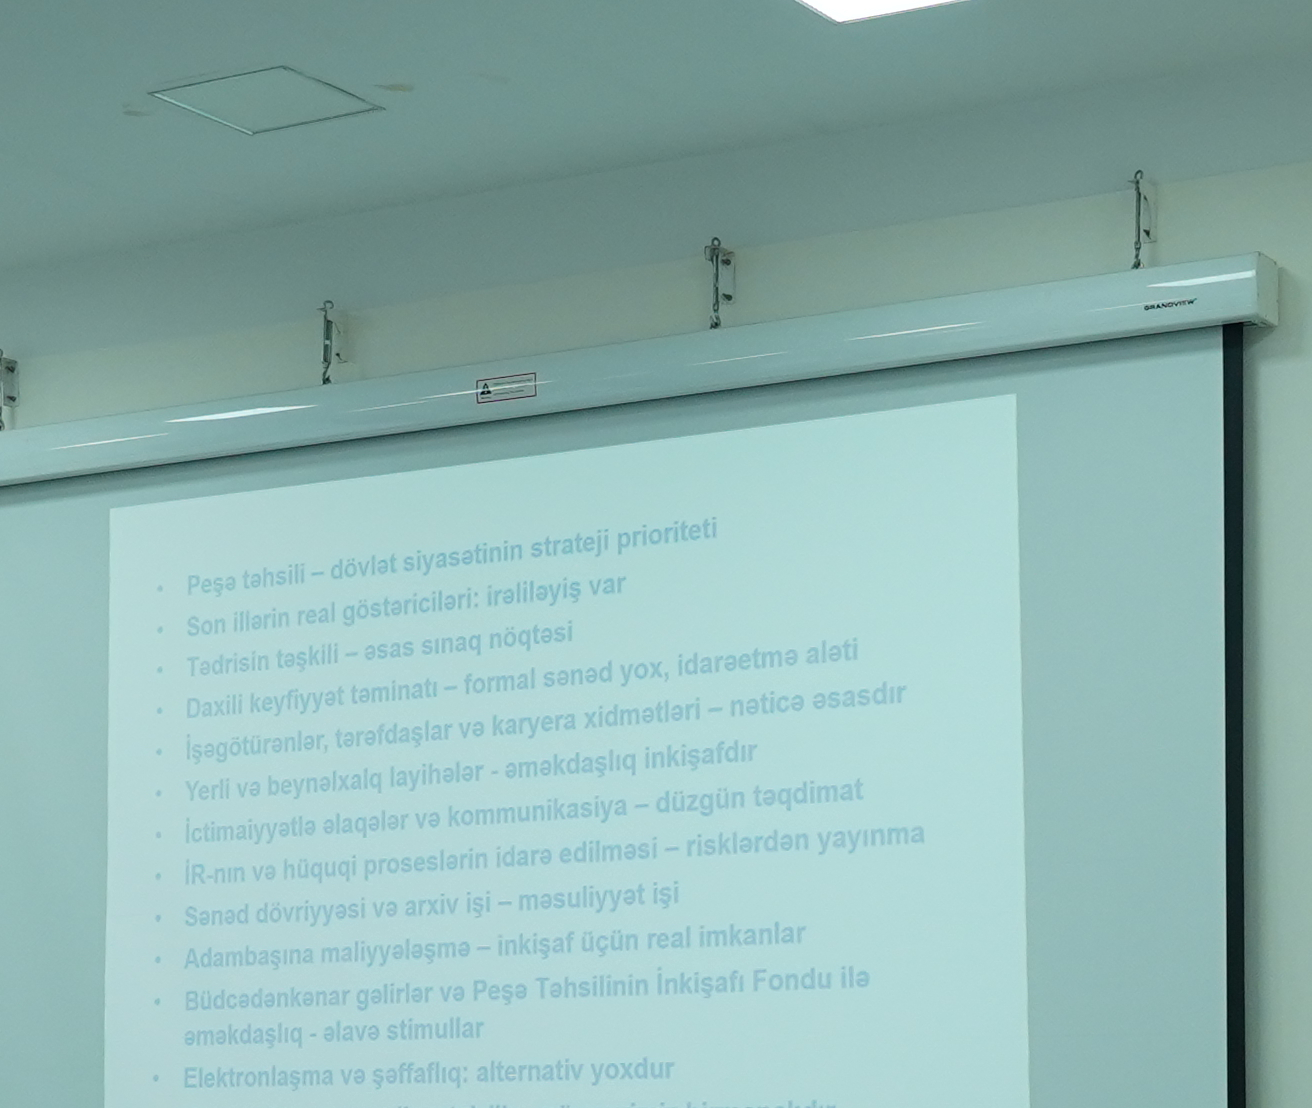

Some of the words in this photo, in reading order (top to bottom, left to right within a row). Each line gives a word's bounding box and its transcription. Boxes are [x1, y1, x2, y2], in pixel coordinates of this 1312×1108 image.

[187, 574, 237, 598] Peşə
[241, 562, 306, 590] təhsili
[330, 553, 398, 580] dövlət
[402, 539, 524, 577] siyasətinin
[530, 528, 610, 559] strateji
[617, 516, 718, 556] prioriteti
[186, 615, 227, 637] Son
[233, 607, 291, 633] illərin
[297, 601, 336, 626] real
[342, 586, 479, 628] göstəriciləri:
[486, 576, 582, 607] irəliləyiş
[588, 575, 628, 596] var
[186, 650, 270, 677] Tədrisin
[275, 642, 339, 673] təşkili
[363, 640, 415, 661] əsas
[421, 633, 482, 657] sınaq
[488, 619, 574, 652] nöqtəsi
[186, 693, 243, 719] Daxili
[249, 685, 345, 717] keyfiyyət
[350, 677, 438, 705] təminatı
[463, 666, 536, 695] formal
[542, 659, 613, 688] sənəd
[619, 660, 670, 688] yox,
[677, 647, 799, 677] idarəetmə
[805, 636, 859, 665] aləti
[186, 729, 329, 765] İşəgötürənlər,
[334, 719, 454, 749] tərəfdaşlar
[458, 720, 486, 740] və
[491, 712, 577, 740] karyera
[583, 696, 701, 730] xidmətləri
[729, 690, 805, 718] nəticə
[812, 680, 908, 710] əsasdır
[185, 777, 230, 802] Yerli
[236, 780, 261, 798] və
[267, 767, 383, 800] beynəlxalq
[389, 760, 485, 792] layihələr
[504, 748, 637, 780] əməkdaşlıq
[644, 739, 759, 772] inkişafdır
[185, 815, 317, 845] İctimaiyyətlə
[322, 809, 410, 839] əlaqələr
[414, 811, 441, 830] və
[447, 795, 628, 828] kommunikasiya
[655, 787, 746, 817] düzgün
[752, 777, 865, 812] təqdimat
[184, 858, 246, 885] İR-nın
[251, 864, 277, 882] və
[283, 854, 357, 884] hüquqi
[363, 847, 489, 882] proseslərin
[496, 844, 553, 869] idarə
[558, 836, 658, 865] edilməsi
[686, 828, 810, 858] risklərdən
[816, 825, 926, 856] yayınma
[184, 903, 250, 927] Sənəd
[255, 896, 366, 928] dövriyyəsi
[372, 900, 399, 919] və
[404, 892, 460, 917] arxiv
[466, 890, 491, 919] işi
[518, 883, 646, 914] məsuliyyət
[652, 880, 680, 910] işi
[183, 945, 314, 971] Adambaşına
[320, 938, 471, 968] maliyyələşmə
[497, 930, 576, 960] inkişaf
[581, 929, 639, 958] üçün
[647, 925, 692, 950] real
[698, 920, 807, 948] imkanlar
[185, 986, 351, 1012] Büdcədənkənar
[355, 982, 434, 1012] gəlirlər
[439, 985, 466, 1003] və
[472, 979, 528, 1006] Peşə
[534, 973, 649, 1000] Təhsilinin
[656, 966, 745, 999] İnkişafı
[752, 966, 833, 993] Fondu
[840, 965, 871, 989] ilə
[183, 1022, 303, 1050] əməkdaşlıq
[322, 1020, 381, 1043] əlavə
[386, 1016, 485, 1041] stimullar
[183, 1064, 334, 1092] Elektronlaşma
[339, 1068, 366, 1086] və
[372, 1061, 468, 1091] şəffaflıq:
[476, 1058, 584, 1083] alternativ
[590, 1056, 676, 1087] yoxdur
